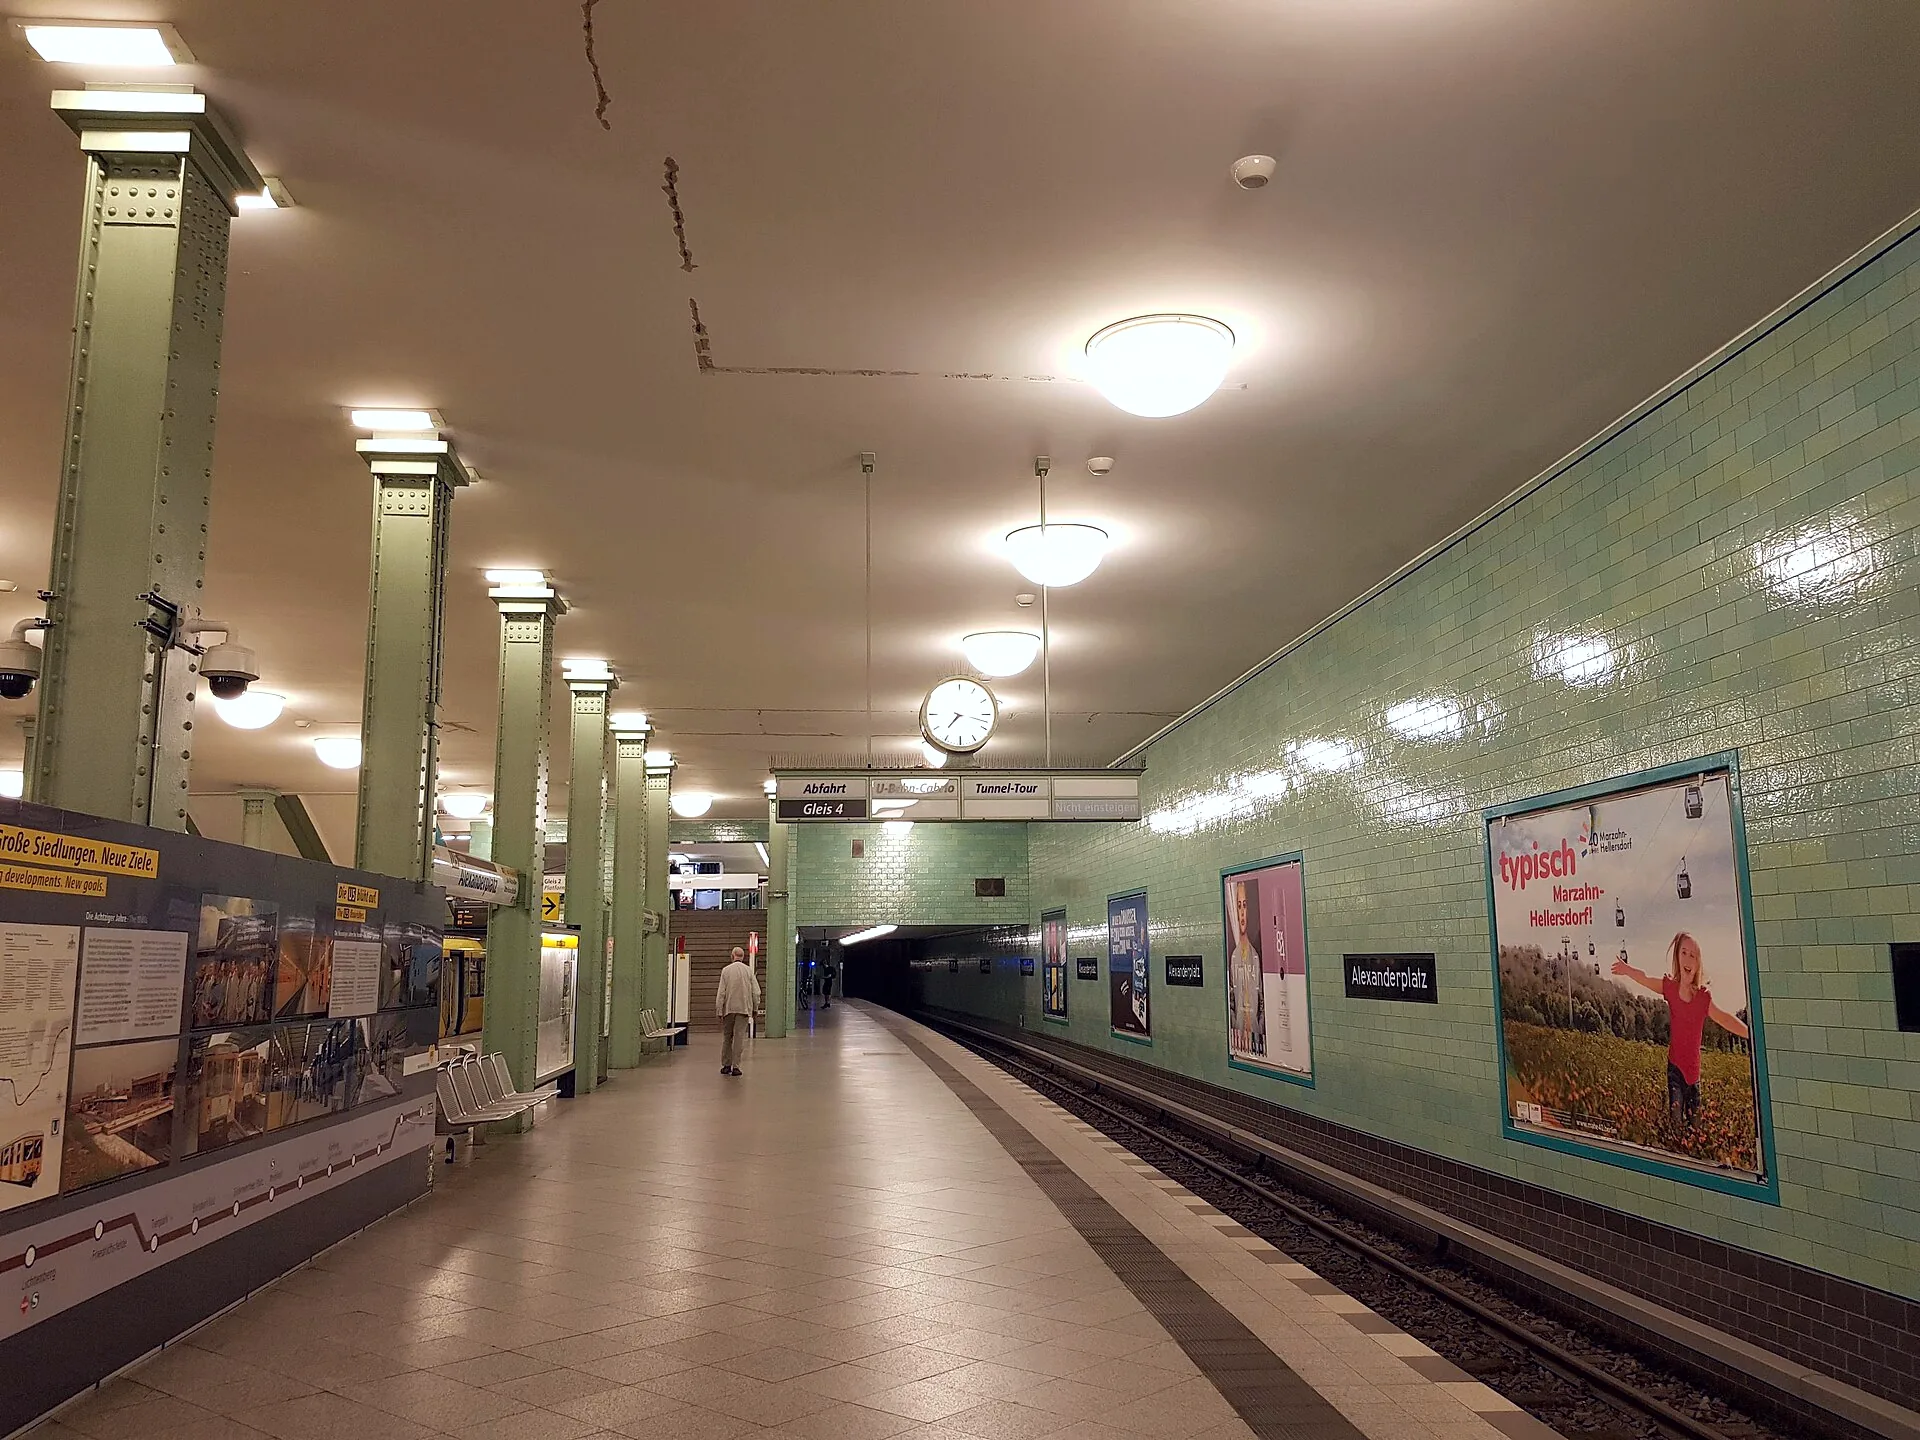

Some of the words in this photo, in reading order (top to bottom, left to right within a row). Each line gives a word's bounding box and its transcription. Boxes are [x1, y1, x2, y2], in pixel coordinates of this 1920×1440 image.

[803, 783, 846, 794] Abfahrt
[975, 783, 1038, 794] Tunnel-Tour
[803, 803, 833, 815] Gleis
[835, 803, 844, 815] 4
[1055, 802, 1081, 813] Nicht
[1084, 802, 1137, 814] einsteigen
[1588, 831, 1599, 847] 40
[1600, 827, 1628, 842] Marzahn-
[1600, 837, 1633, 853] Hellersdorf
[33, 835, 98, 866] Siedlungen.
[101, 846, 127, 868] Neue
[128, 851, 154, 872] Ziele.
[1498, 838, 1577, 891] typisch
[5, 867, 63, 889] developments.
[65, 875, 82, 889] New
[83, 878, 105, 894] goals.
[1552, 881, 1605, 903] Marzahn-
[1530, 906, 1593, 927] Hellersdorf!
[1168, 963, 1200, 980] Alexanderplatz
[1351, 965, 1428, 992] Alexanderplatz
